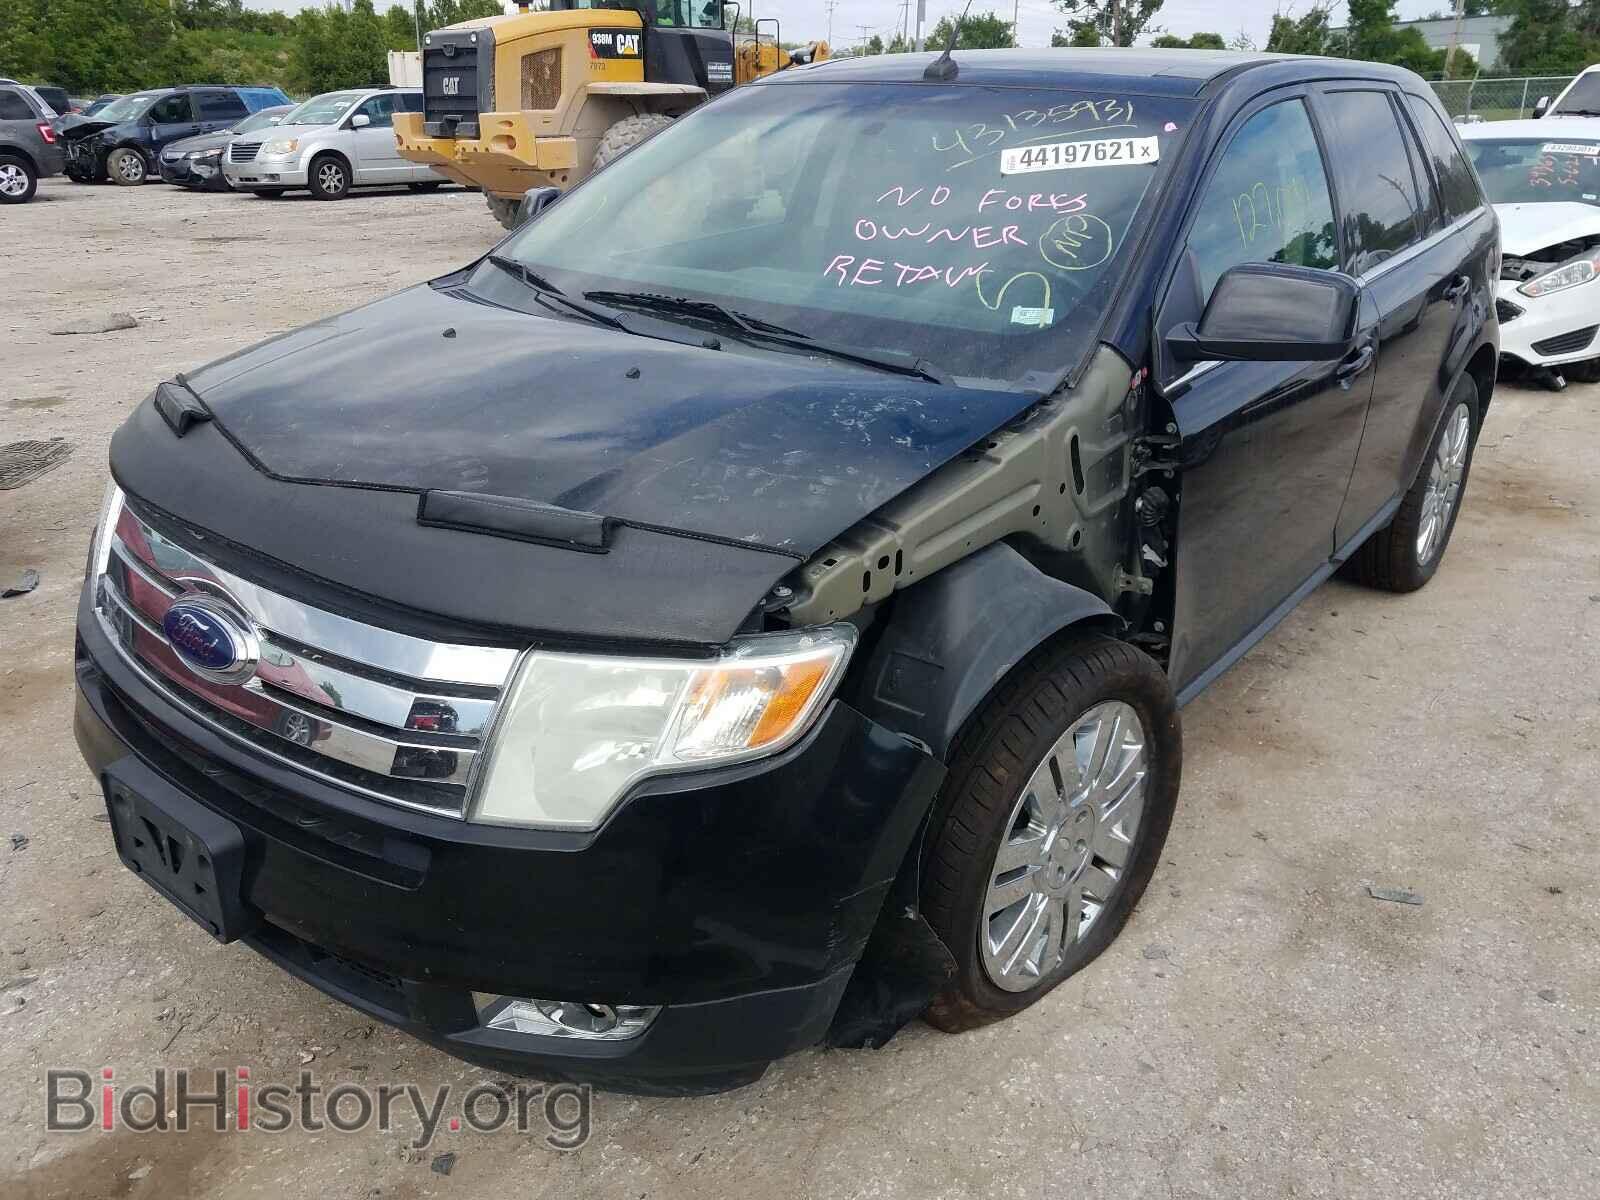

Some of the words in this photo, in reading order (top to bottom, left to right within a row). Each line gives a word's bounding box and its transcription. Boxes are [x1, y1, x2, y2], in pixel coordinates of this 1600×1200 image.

[592, 33, 613, 45] 938M
[616, 33, 640, 55] CAT
[442, 76, 460, 95] CAT
[1020, 140, 1135, 167] 44197621
[876, 185, 951, 207] NO
[978, 188, 1089, 214] FORKS
[855, 218, 1028, 249] OWNER
